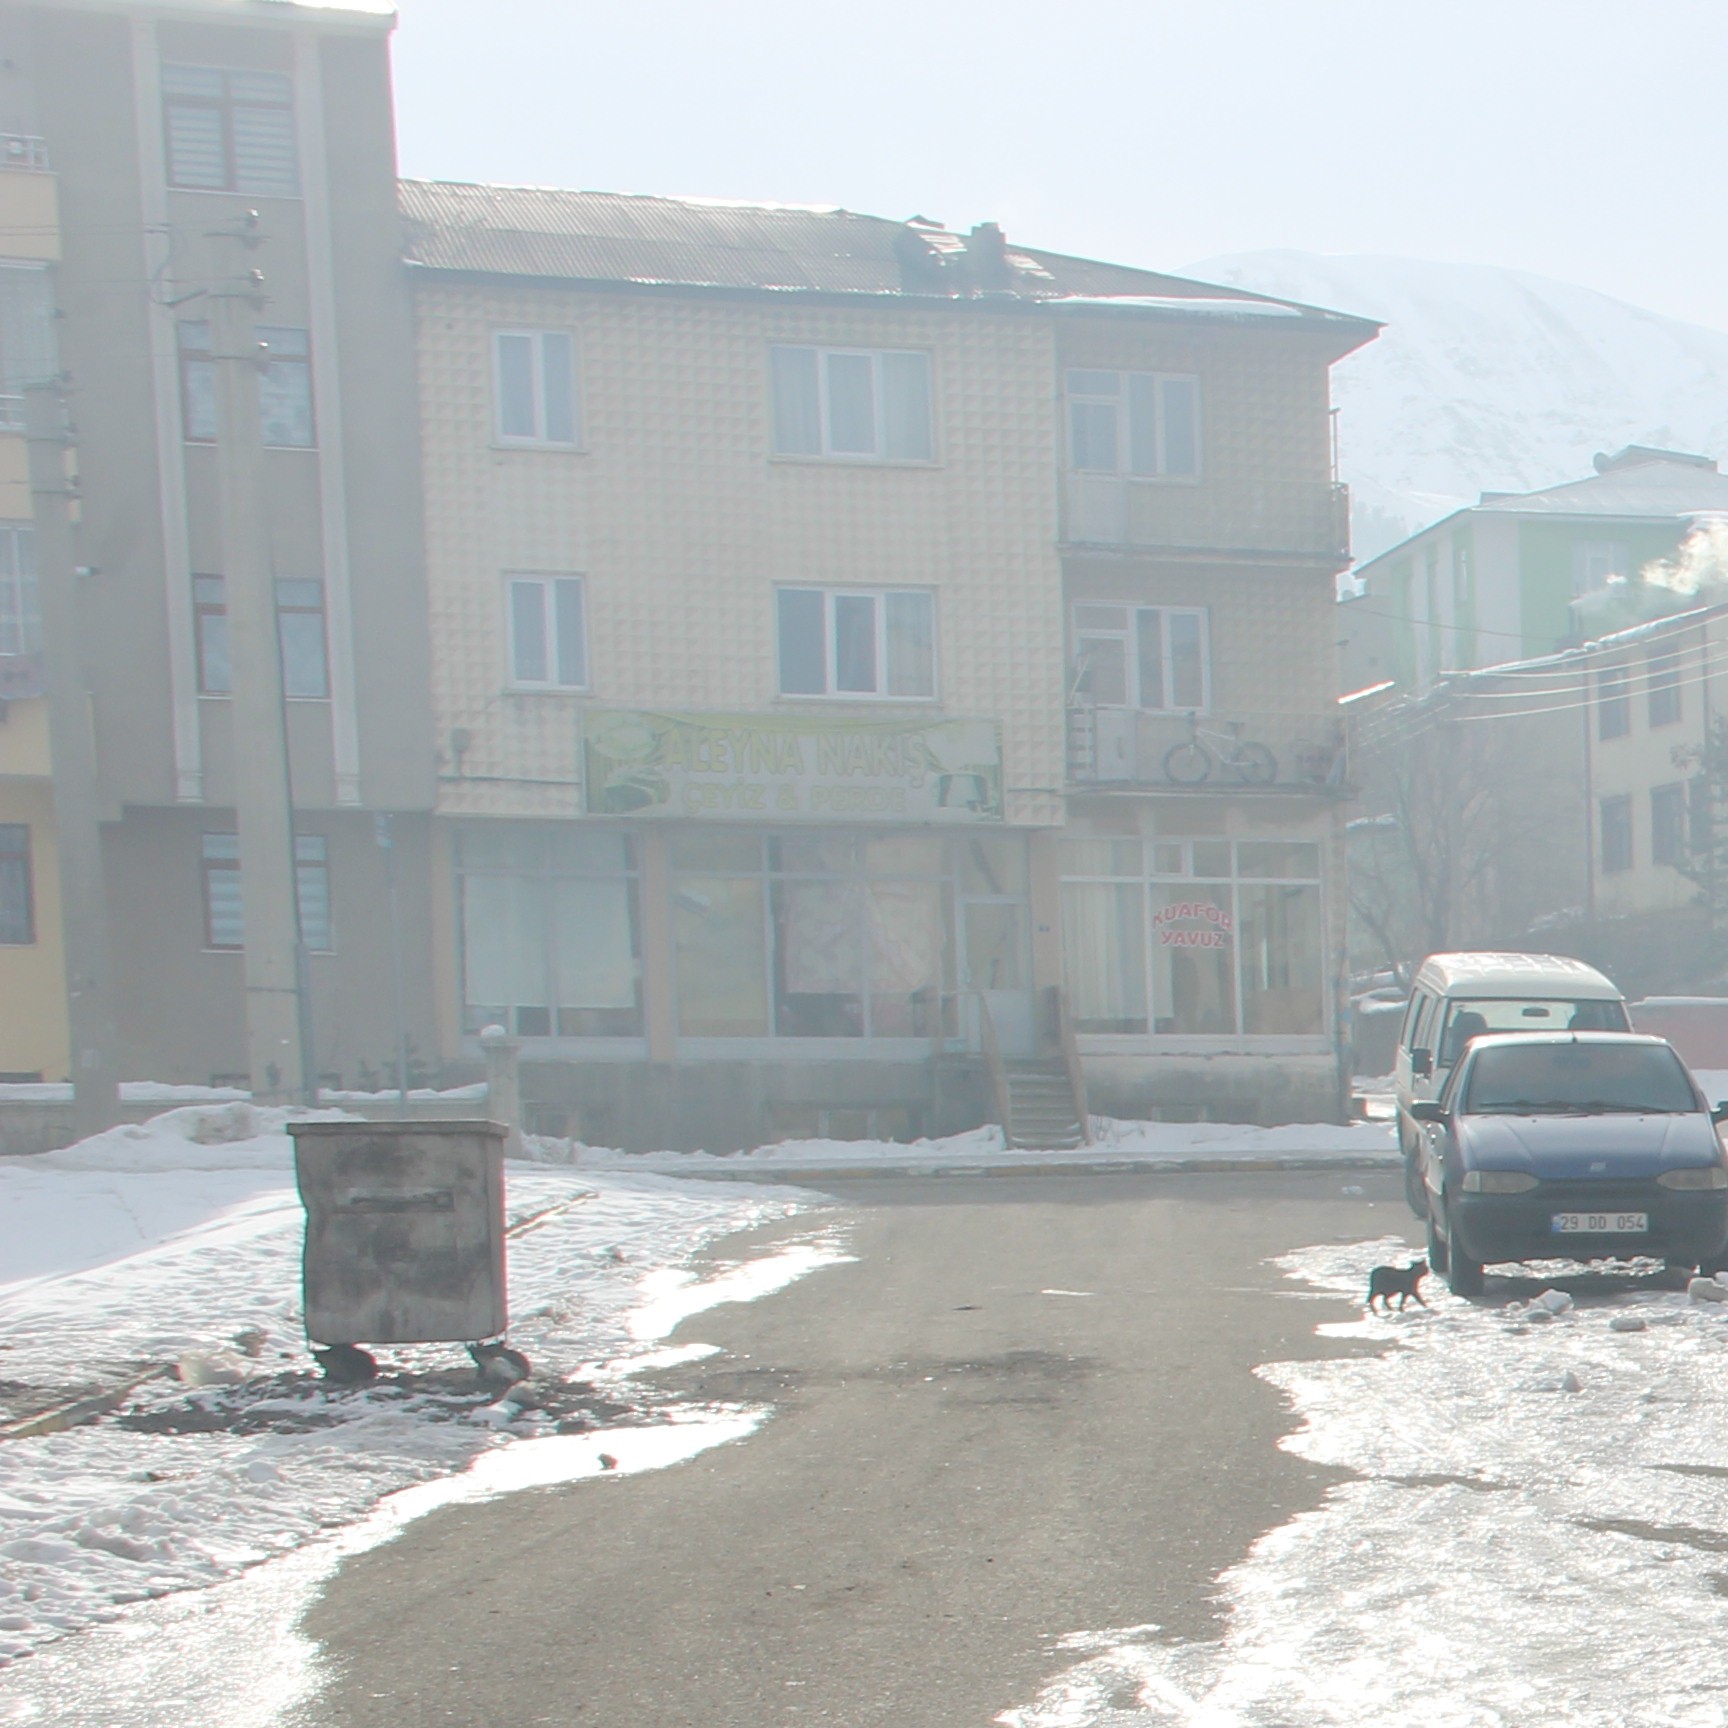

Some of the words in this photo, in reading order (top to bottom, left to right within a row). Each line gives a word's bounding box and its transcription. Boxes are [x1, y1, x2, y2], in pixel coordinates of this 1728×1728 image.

[663, 729, 805, 775] ALEYNA
[682, 776, 767, 814] ÇEYİZ
[776, 784, 799, 811] &
[810, 785, 907, 812] PERDE
[1161, 931, 1224, 948] YAVUZ
[1561, 1215, 1579, 1230] 29
[1588, 1215, 1607, 1230] DD
[1617, 1215, 1645, 1230] 054
